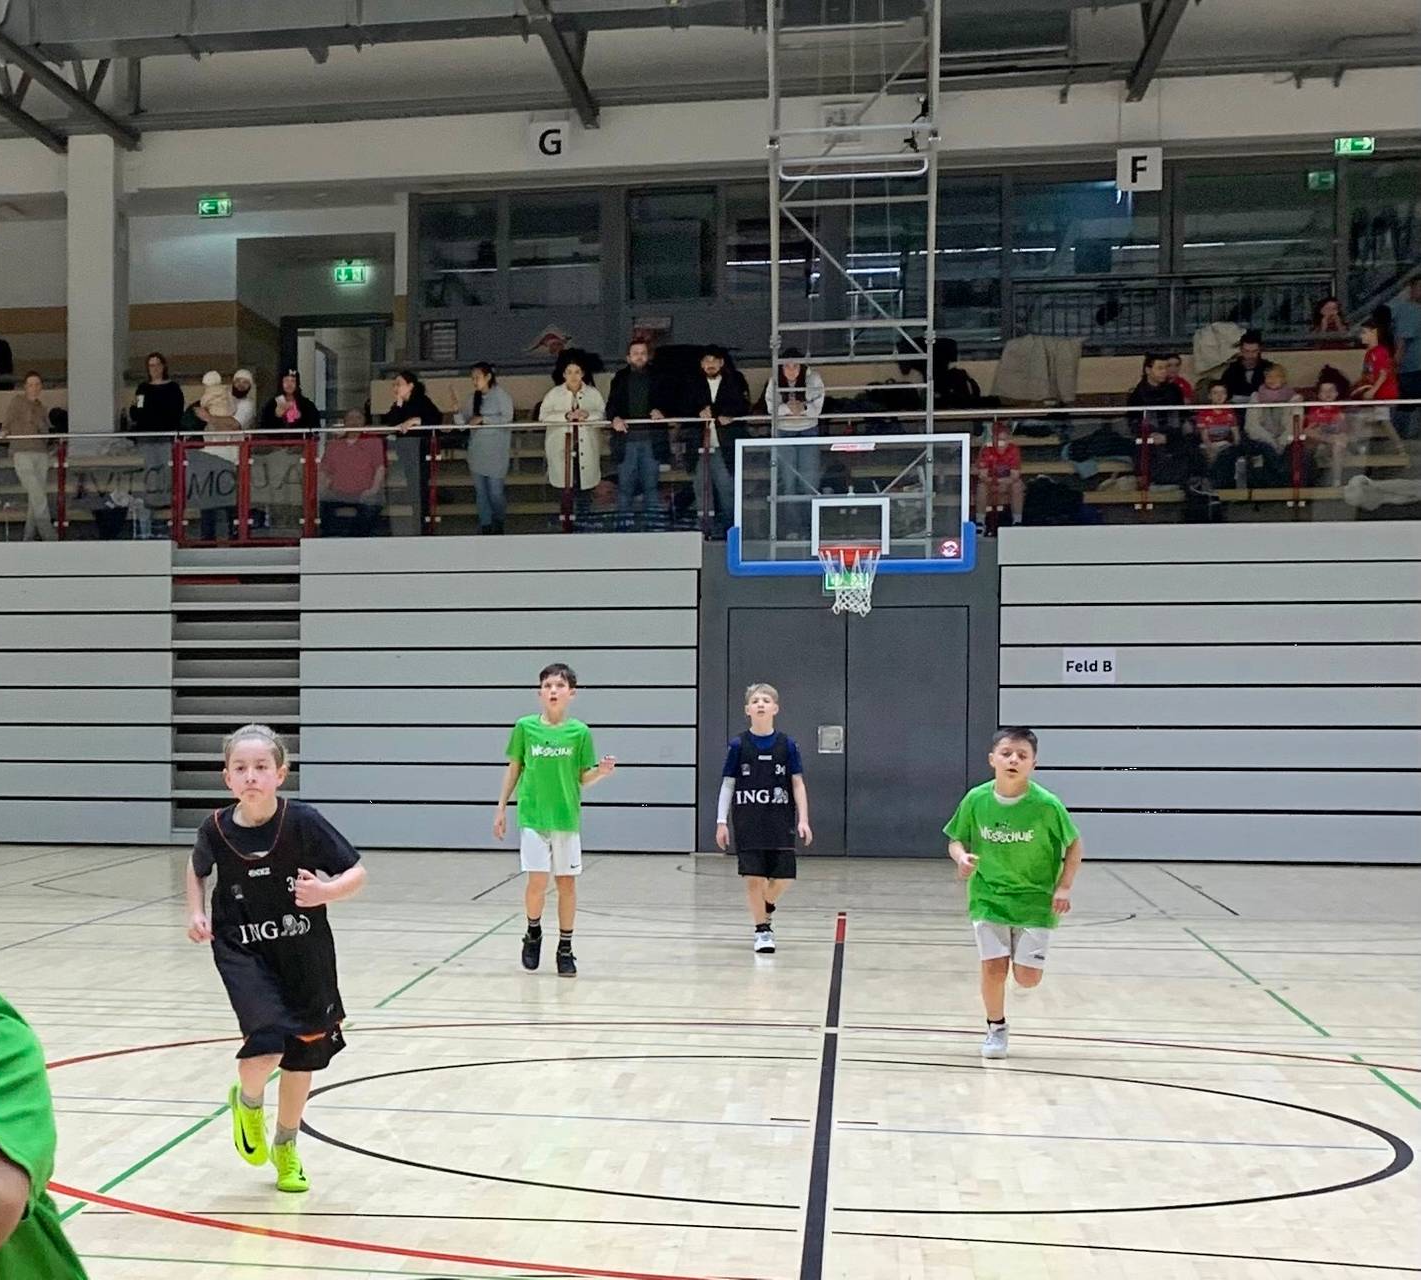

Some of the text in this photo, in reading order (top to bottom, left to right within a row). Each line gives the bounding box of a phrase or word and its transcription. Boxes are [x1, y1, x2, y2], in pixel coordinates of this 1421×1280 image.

[538, 129, 562, 155] G
[1131, 155, 1148, 183] F
[1066, 659, 1113, 673] Feld B
[736, 789, 770, 805] ING
[239, 920, 279, 945] ING
